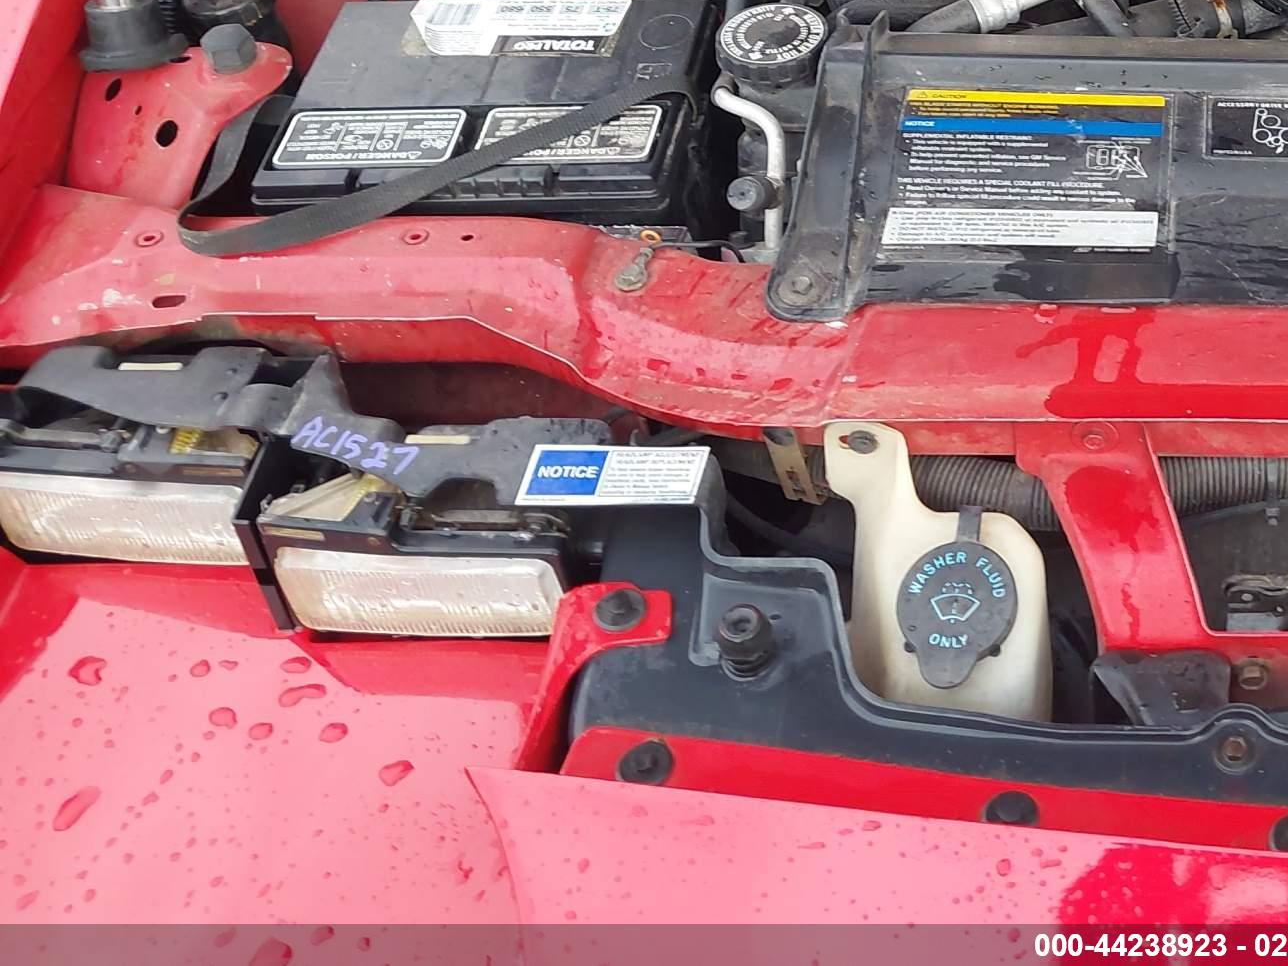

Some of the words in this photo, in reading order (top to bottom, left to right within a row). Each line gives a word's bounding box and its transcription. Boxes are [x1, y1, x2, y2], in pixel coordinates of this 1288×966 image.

[904, 120, 935, 128] NOTICE
[290, 416, 420, 475] AC1527
[537, 465, 600, 480] NOTICE
[907, 550, 967, 596] WASHER
[975, 556, 1006, 600] FLUID
[928, 634, 969, 648] ONLY
